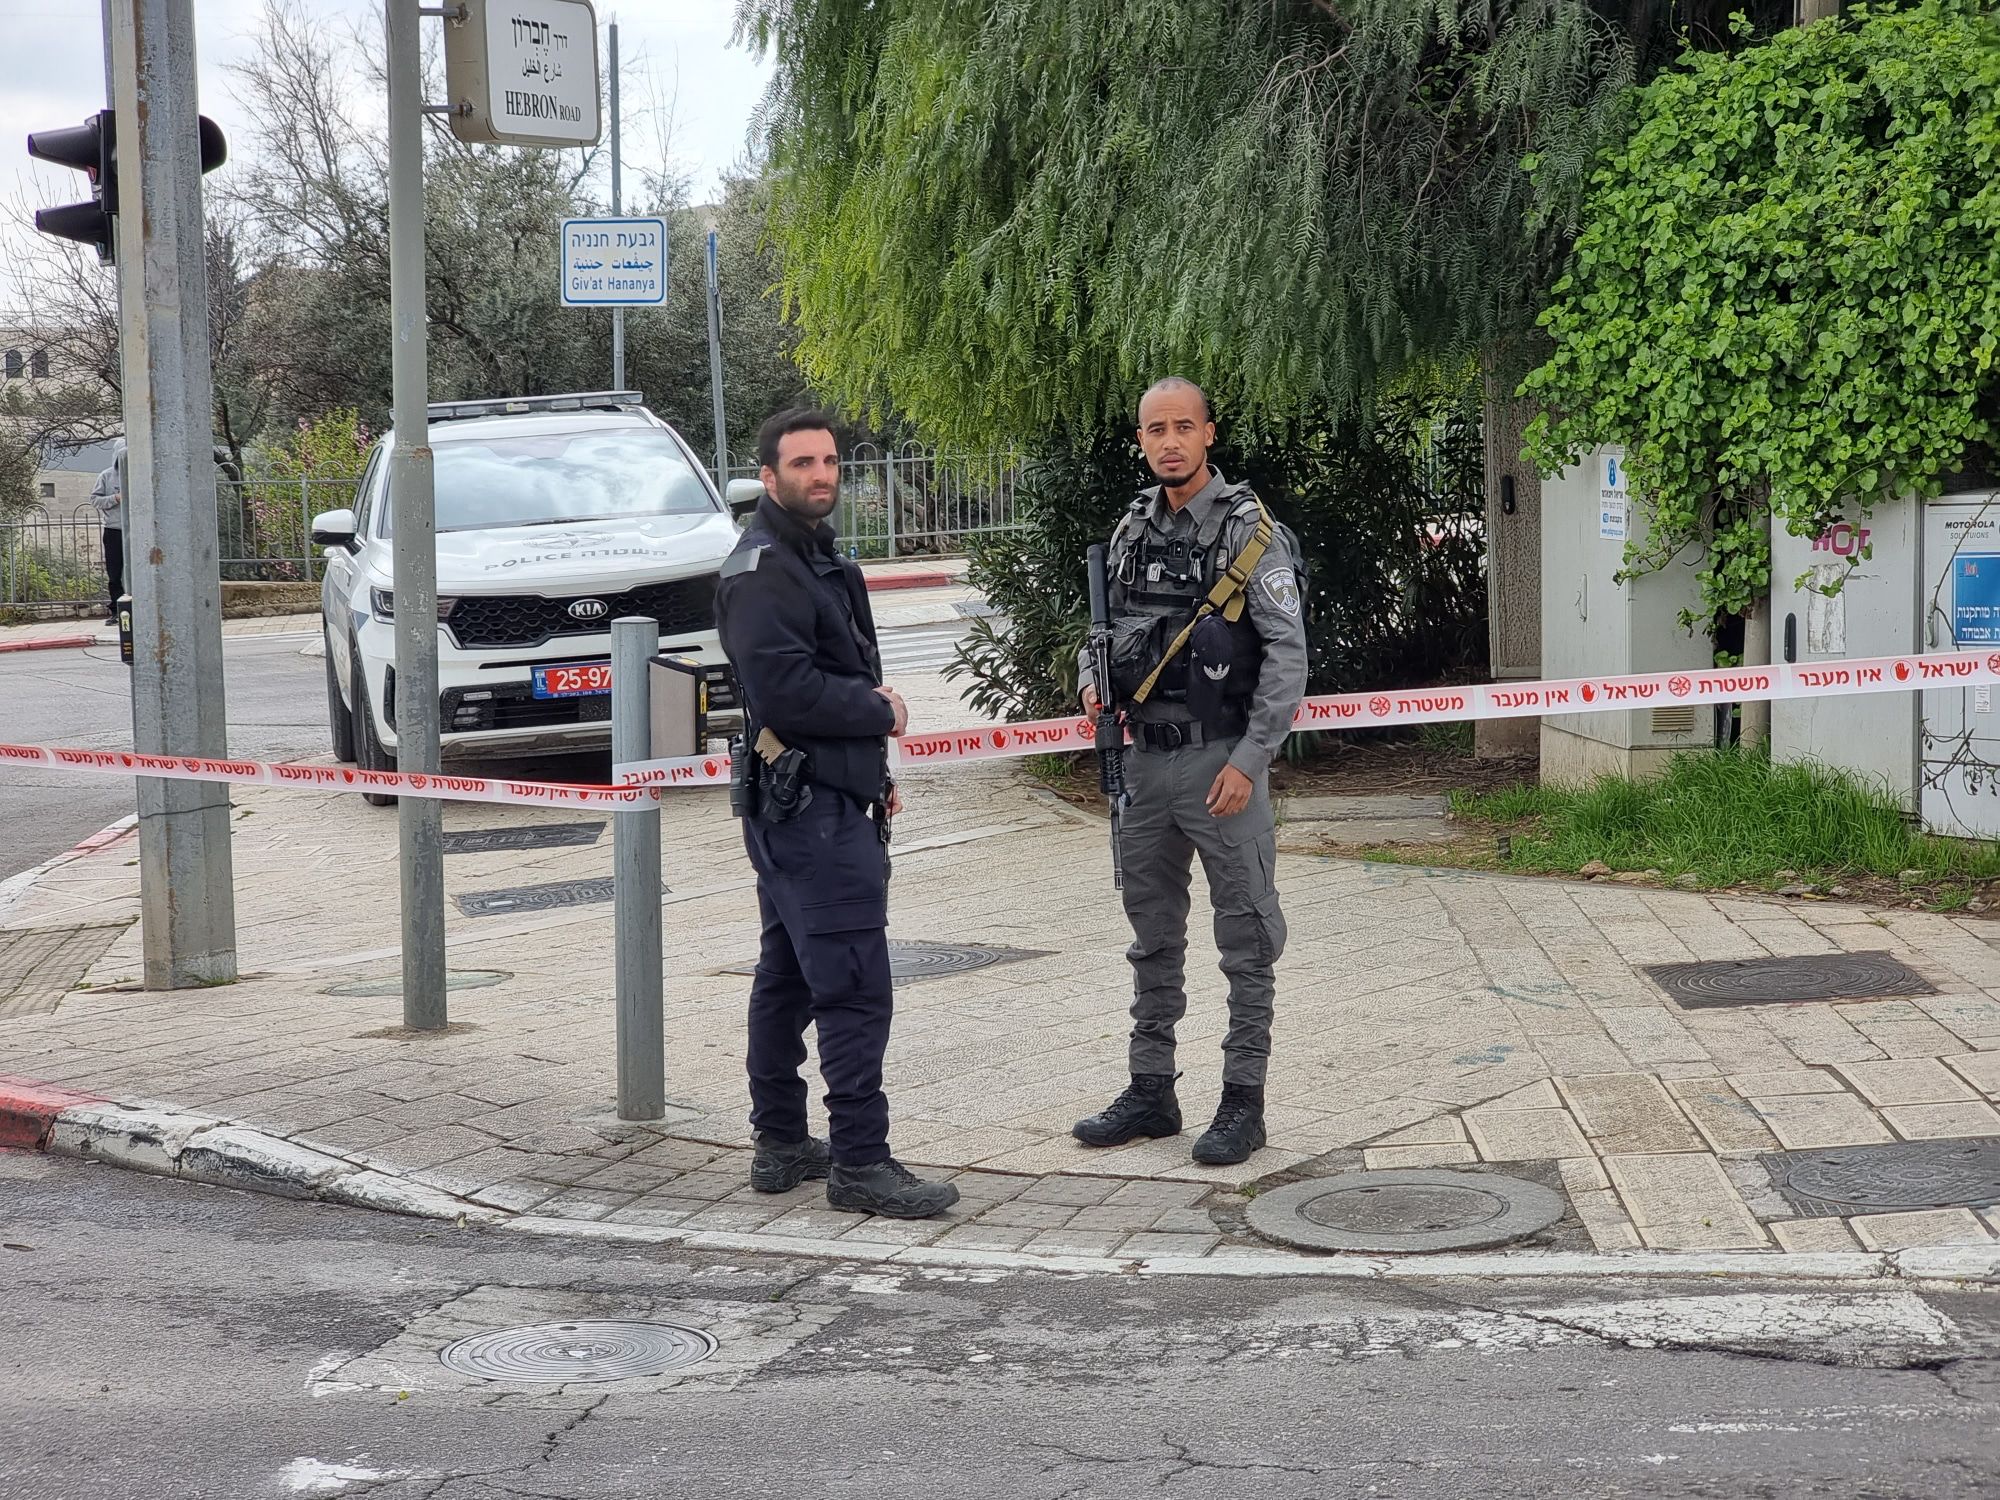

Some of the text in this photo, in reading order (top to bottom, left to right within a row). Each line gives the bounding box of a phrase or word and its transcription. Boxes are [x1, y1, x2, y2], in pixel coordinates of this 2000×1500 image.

[553, 33, 567, 51] דרך
[522, 58, 562, 83] شارع الخليل
[505, 90, 581, 122] HEBRON ROAD
[572, 232, 655, 248] גבעת חנניה
[573, 257, 603, 273] حننية
[572, 276, 655, 293] Giv'at Hananya
[1945, 520, 1995, 529] MOTOROLA
[484, 552, 572, 571] POLICE
[581, 548, 668, 557] משטרה
[575, 603, 603, 616] KIA
[1956, 606, 1990, 623] מותקנות
[1961, 627, 1991, 639] אבטחה
[1798, 660, 1979, 687] ישראל אין מעבר
[1491, 675, 1770, 707] משטרת ישראל אין מעבר
[1307, 695, 1464, 719] משטרת ישראל
[905, 727, 1069, 757] ישראל אין מעבר
[0, 746, 40, 759] משטר
[57, 751, 256, 776] משטרת ישראל אין מעבר
[276, 767, 485, 792] משטרת ישראל אין מעבר
[622, 767, 694, 786] אין מעבר
